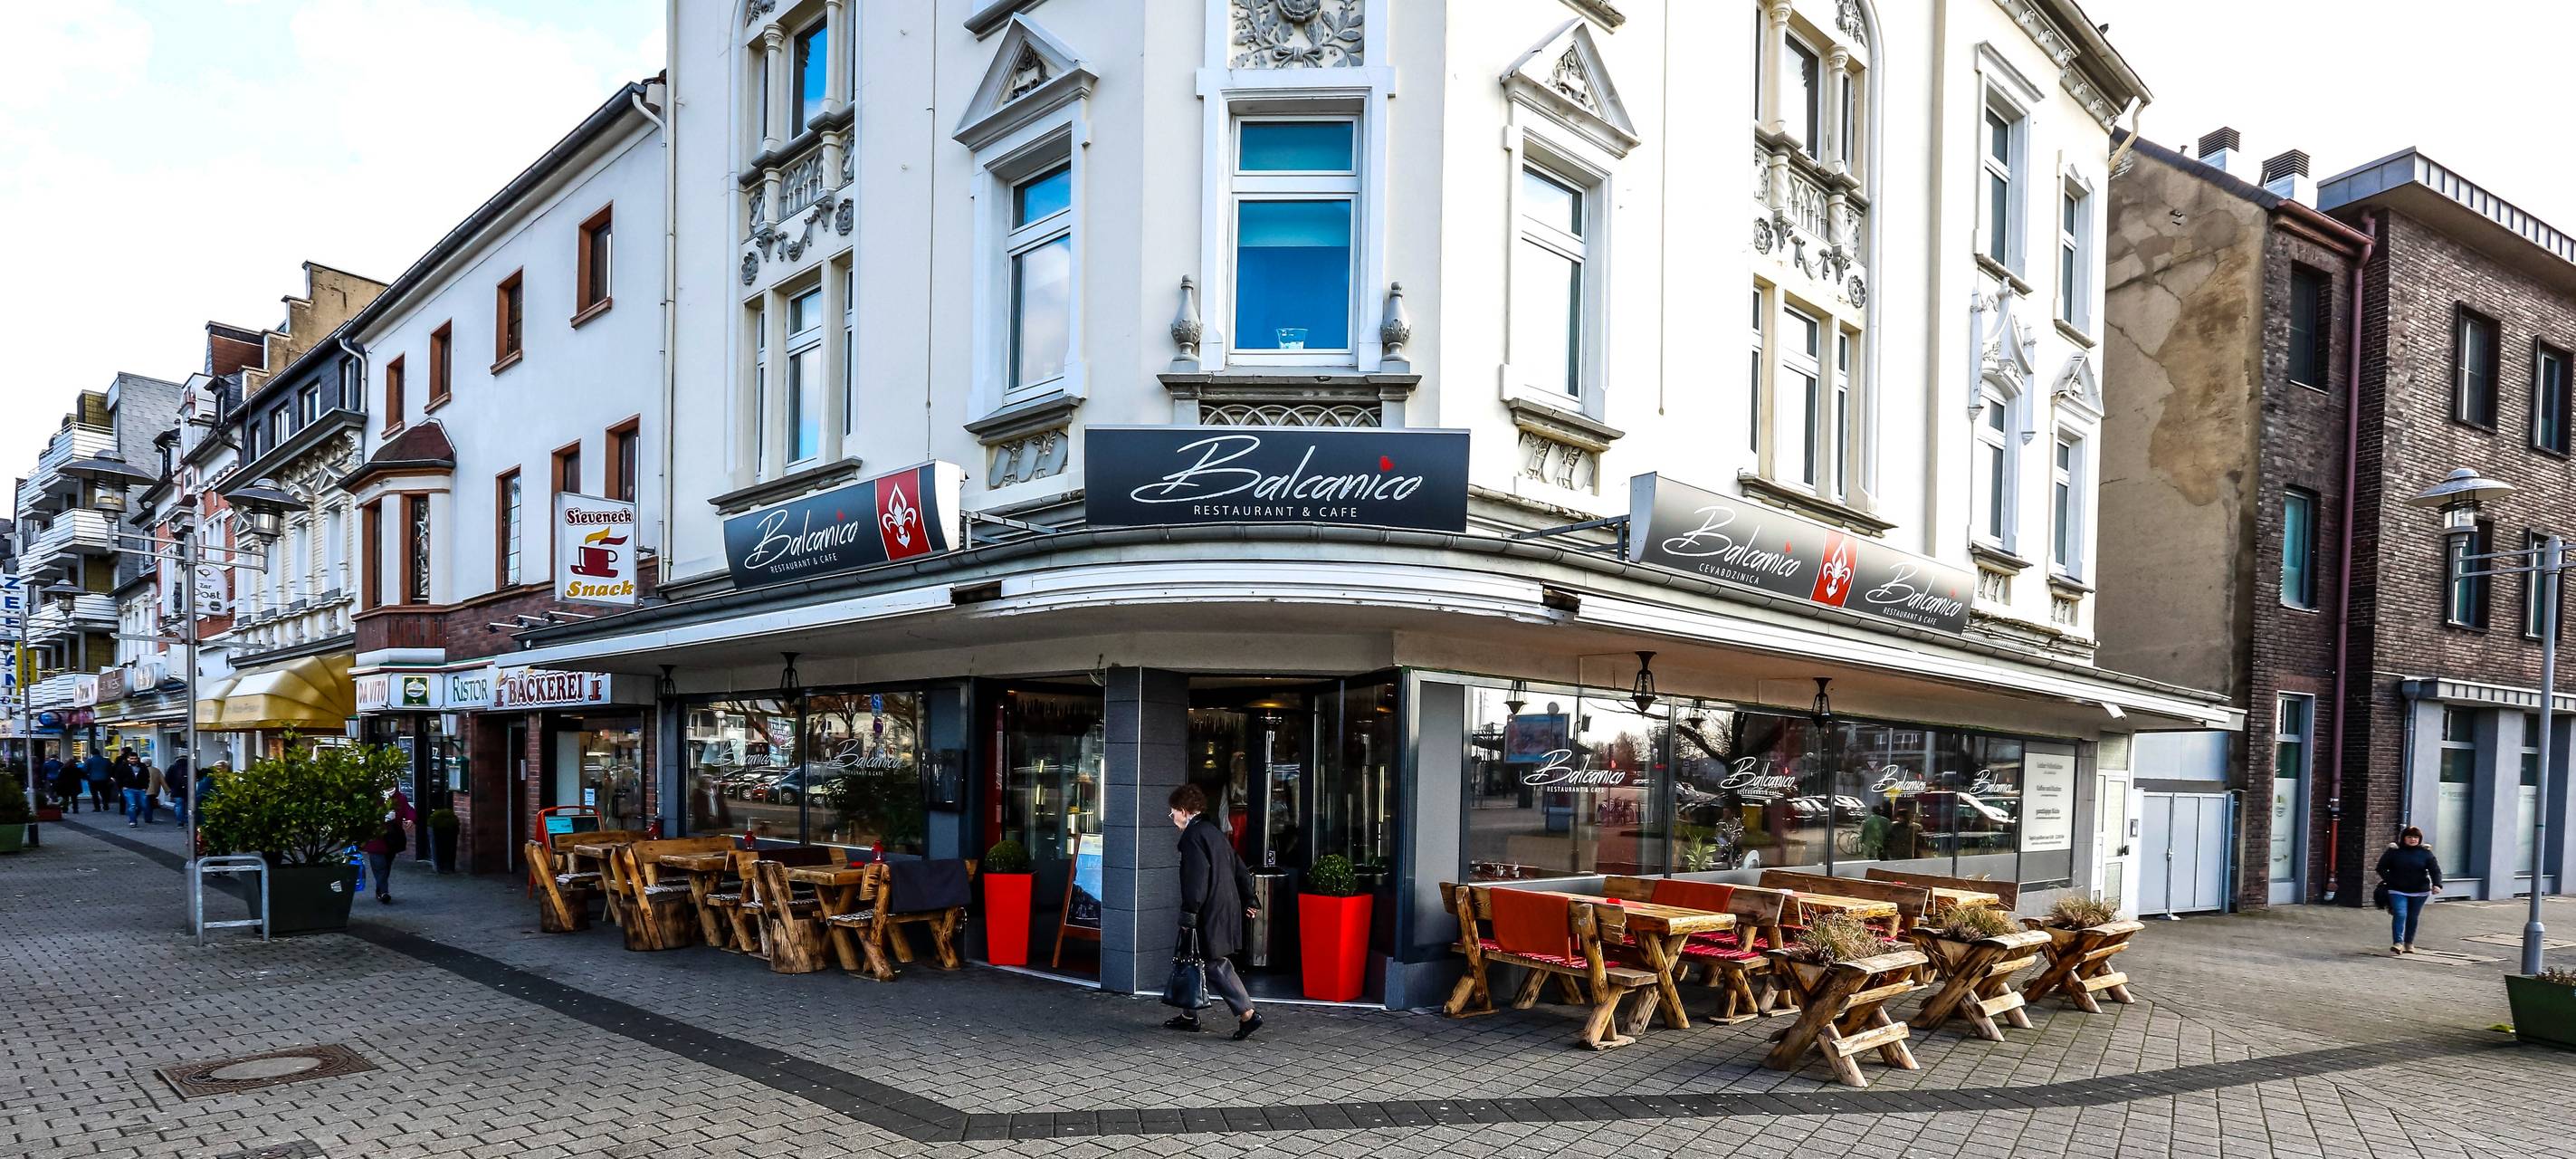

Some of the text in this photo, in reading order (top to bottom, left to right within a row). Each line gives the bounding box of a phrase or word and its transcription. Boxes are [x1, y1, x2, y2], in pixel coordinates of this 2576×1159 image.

[1130, 434, 1424, 503] Balcanico
[566, 507, 633, 524] Sieveneck
[1193, 505, 1359, 519] RESTAURANT & CAFE
[744, 509, 859, 570] Balcanico
[1662, 505, 1801, 579] Balcanico
[769, 560, 812, 574] RESTAURANT
[819, 554, 838, 564] CAFE
[1698, 562, 1760, 585] CEVABDZINICA
[566, 580, 634, 597] Snack
[1865, 563, 1963, 618] Balcanico
[1883, 607, 1918, 620] RESTAURANT
[1923, 616, 1937, 626] CAFE
[358, 680, 386, 704] DA VITO
[508, 670, 584, 704] BÄCKEREI
[826, 739, 900, 769] Balcanico
[1523, 749, 1626, 786] Balcanico
[1720, 756, 1796, 790] Balcanico
[1871, 764, 1927, 793] Balcanico
